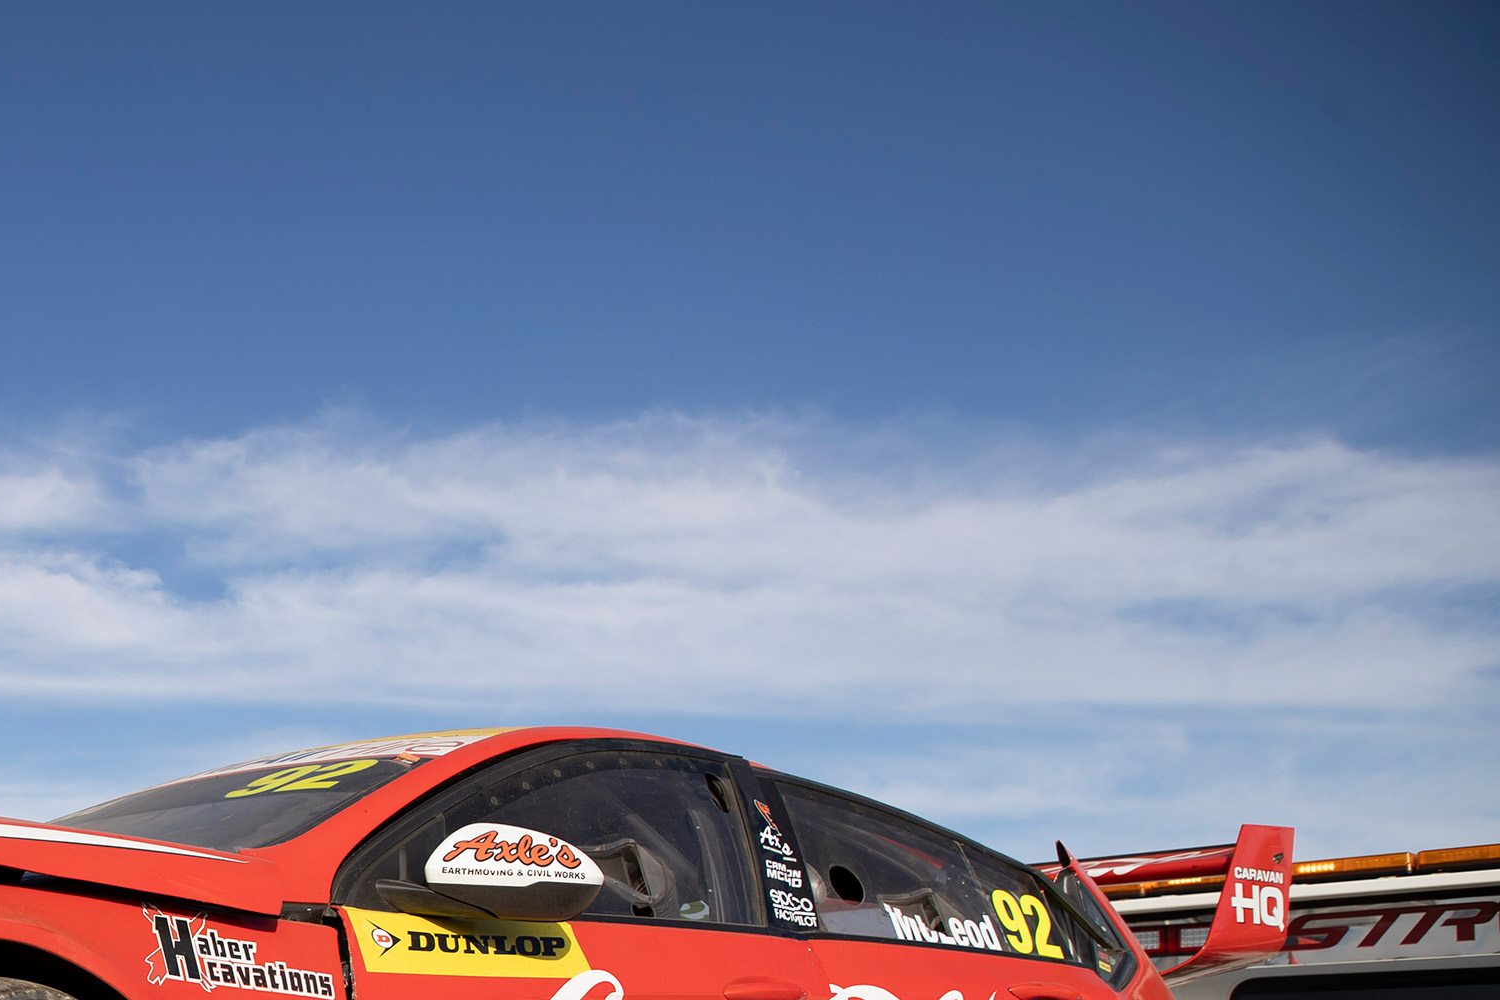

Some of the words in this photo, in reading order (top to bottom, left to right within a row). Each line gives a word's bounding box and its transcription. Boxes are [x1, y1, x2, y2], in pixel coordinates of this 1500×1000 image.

[225, 759, 378, 798] 92
[443, 830, 581, 869] Axle's
[442, 866, 514, 877] EARTHMOVING
[527, 869, 552, 878] CIVIL
[554, 871, 586, 880] WORKS
[1234, 866, 1284, 884] CARAVAN
[991, 889, 1065, 959] 92
[1231, 883, 1285, 932] HQ
[407, 930, 565, 956] DUNLOP
